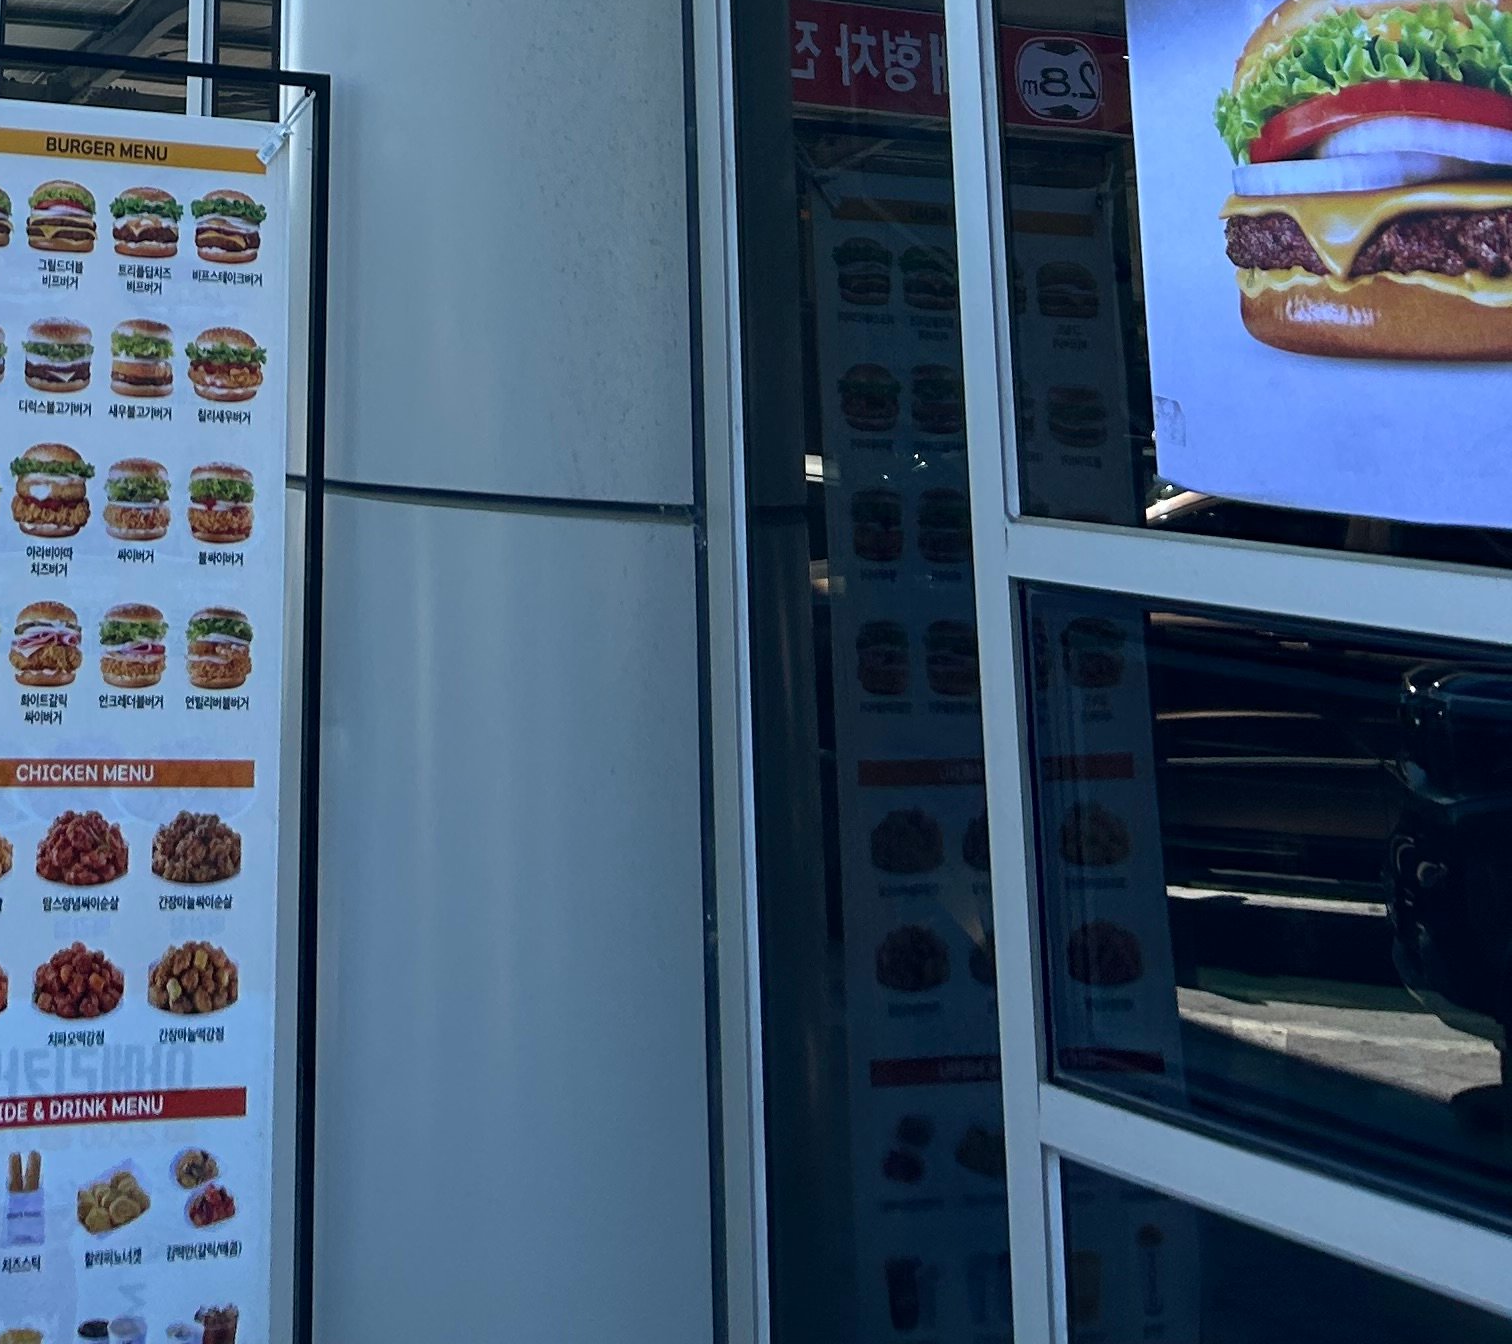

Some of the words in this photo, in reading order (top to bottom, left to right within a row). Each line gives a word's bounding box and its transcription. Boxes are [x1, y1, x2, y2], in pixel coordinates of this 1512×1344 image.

[45, 136, 115, 159] BURGER
[119, 142, 168, 162] MENU
[42, 275, 79, 290] 비프버거
[126, 280, 162, 295] 비프버거
[19, 399, 92, 417] 디럭스불고기버거
[108, 403, 172, 421] 새우불고기버거
[30, 562, 68, 577] 치즈버거
[24, 710, 62, 725] 싸이버거
[16, 764, 98, 782] CHICKEN
[103, 764, 155, 782] MENU
[33, 1103, 46, 1120] &
[49, 1098, 107, 1119] DRINK
[111, 1094, 164, 1116] MENU
